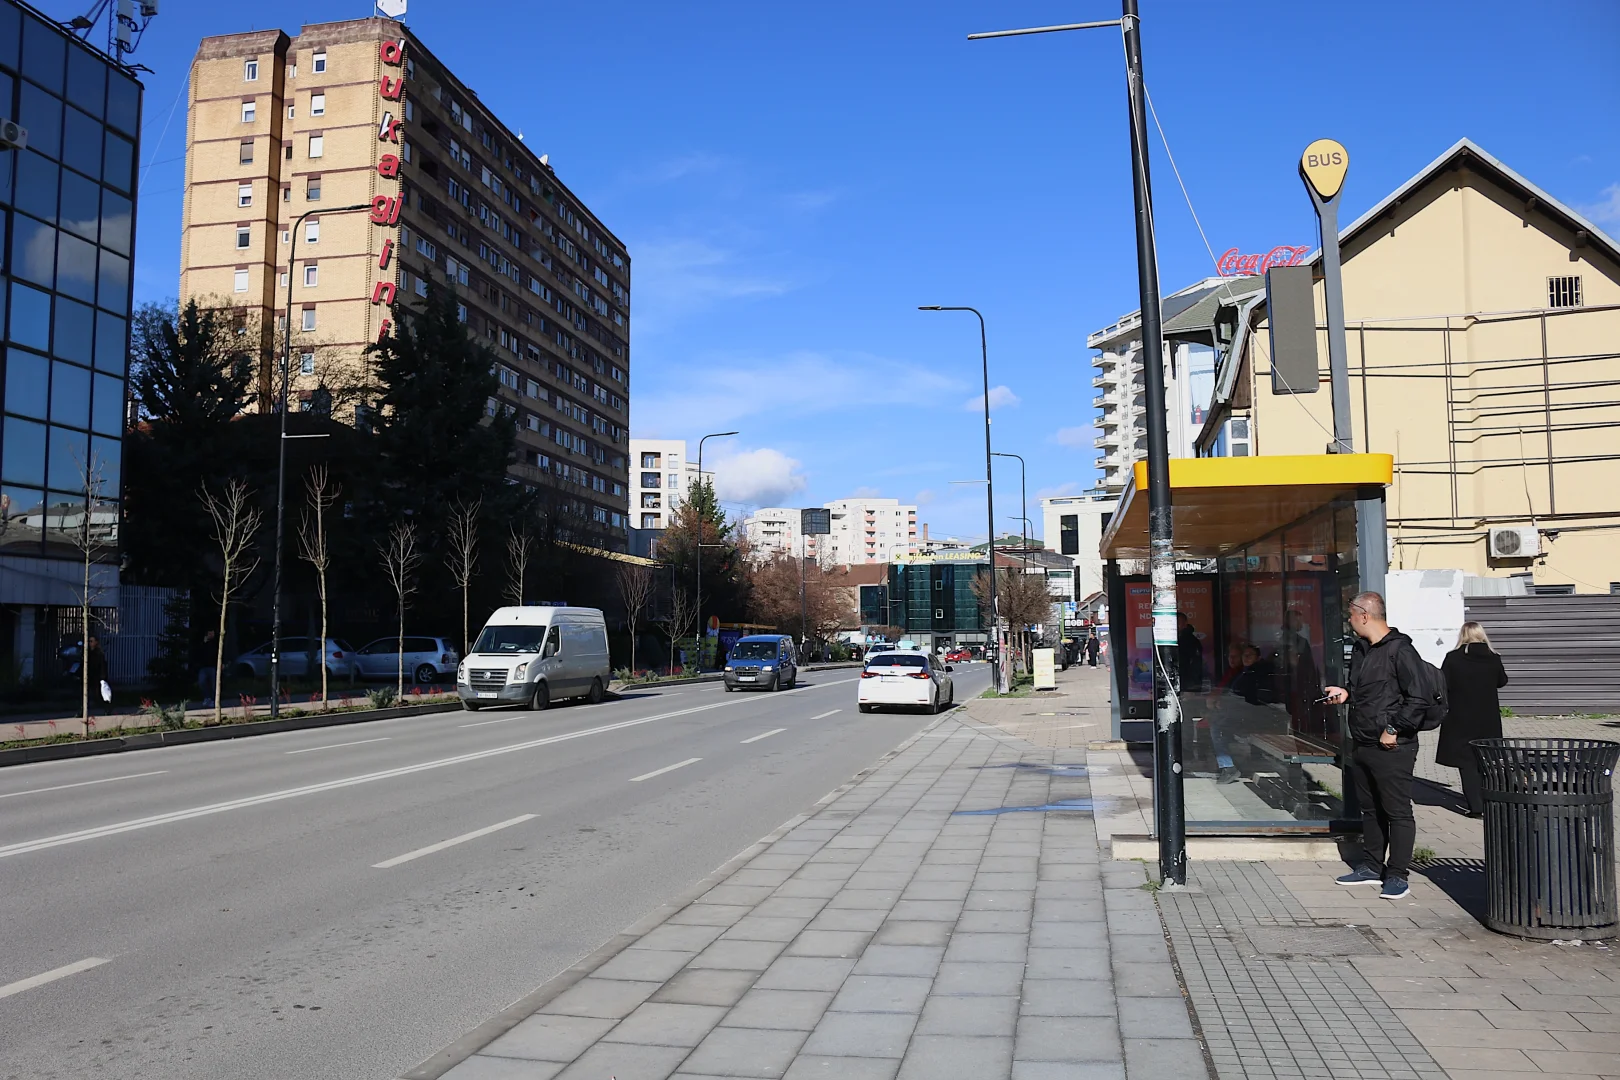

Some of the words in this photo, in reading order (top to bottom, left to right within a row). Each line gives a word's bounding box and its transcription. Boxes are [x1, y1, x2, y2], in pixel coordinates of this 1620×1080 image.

[1307, 152, 1343, 167] BUS
[370, 38, 405, 343] dukagjini
[945, 552, 981, 560] LEASING
